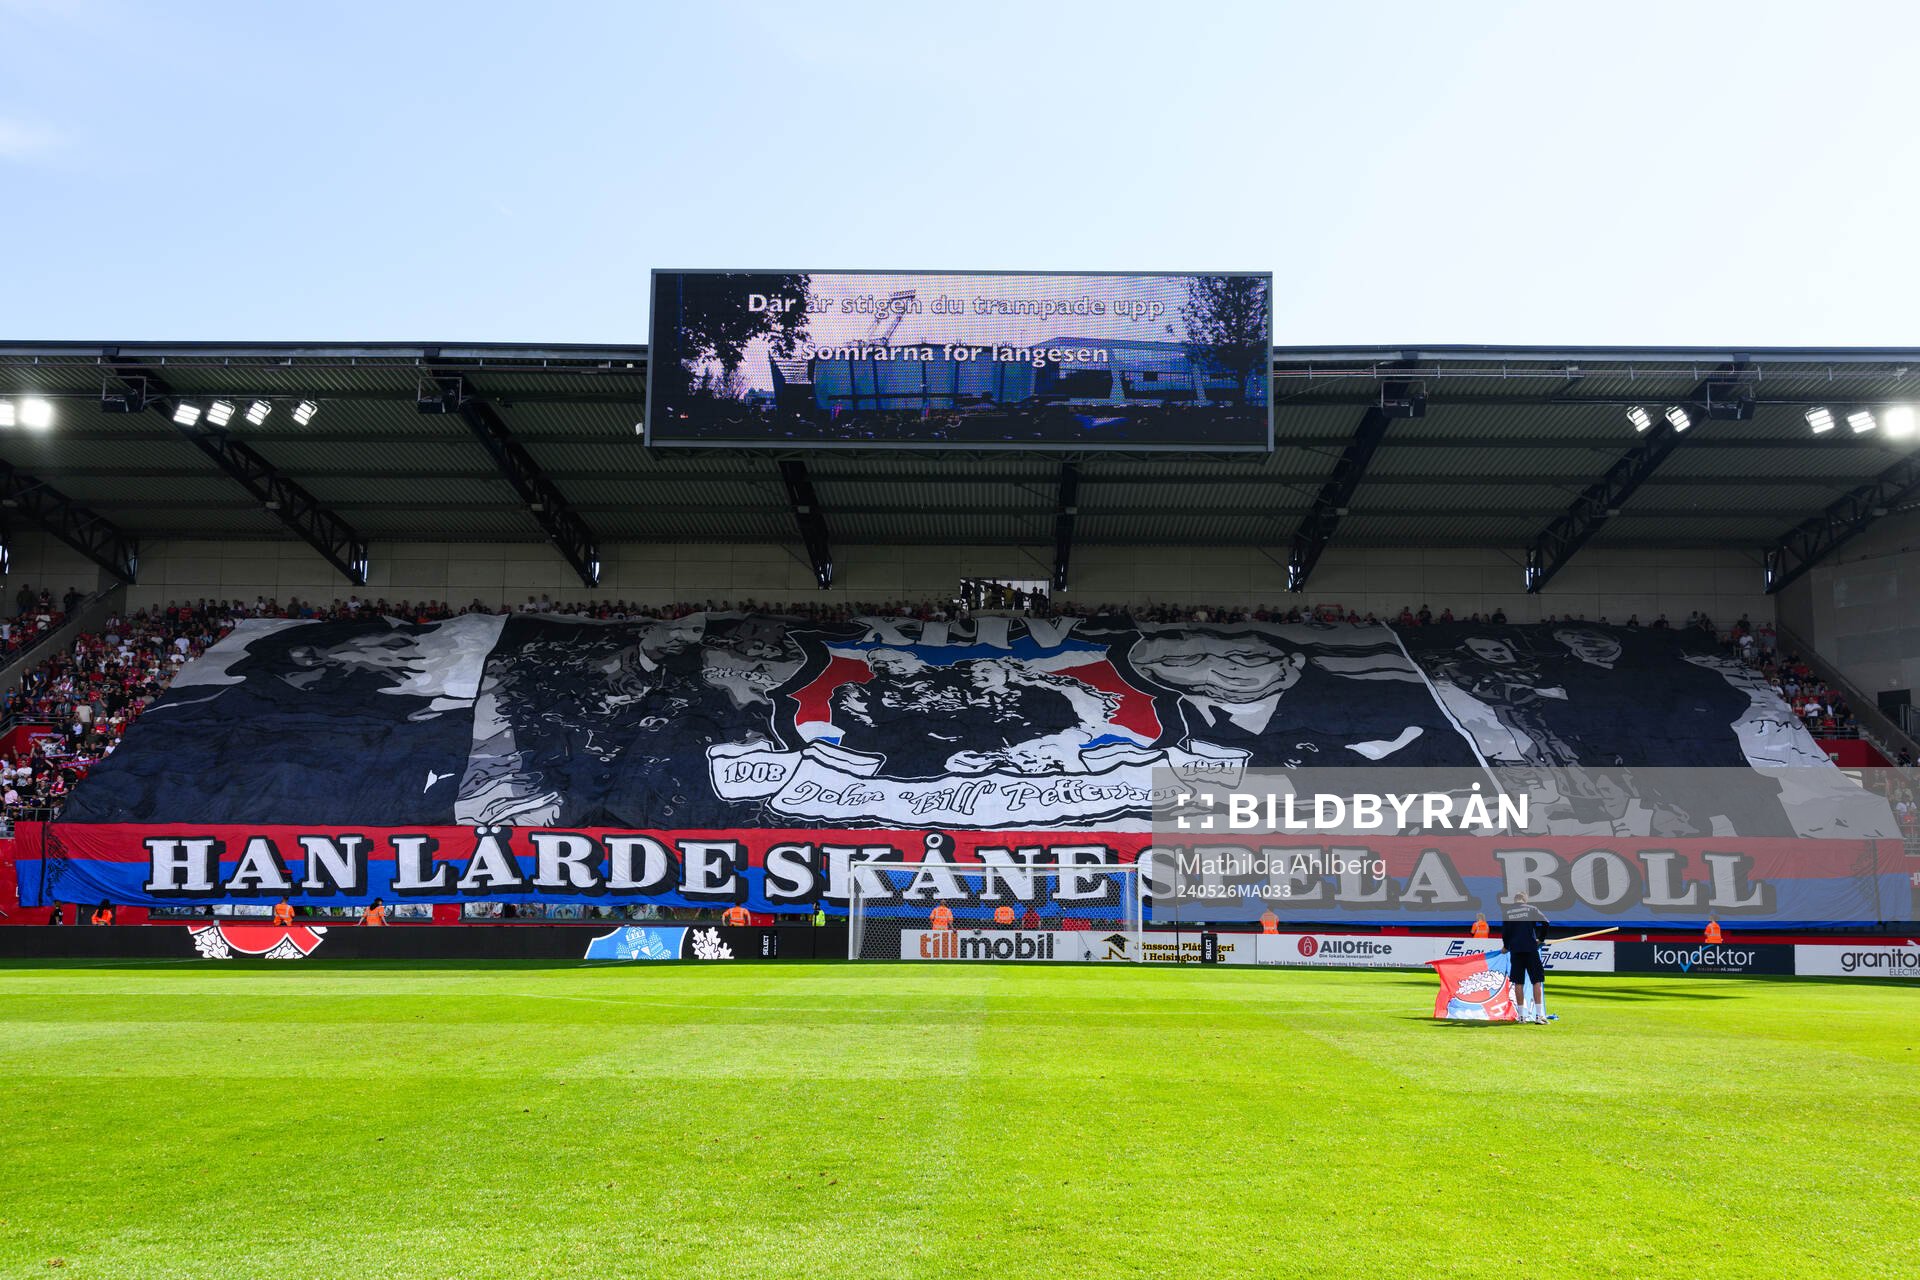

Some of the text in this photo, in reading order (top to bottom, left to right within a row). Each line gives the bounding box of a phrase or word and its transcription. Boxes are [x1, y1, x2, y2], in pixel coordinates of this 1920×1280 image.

[748, 293, 1165, 321] Där är stigen du trampade upp
[801, 343, 934, 361] Somrarna
[943, 341, 982, 362] för
[724, 761, 786, 783] 1908
[782, 780, 885, 806] John
[144, 825, 1763, 906] HAN LÄRDE SKÅNE SPELA BOLL
[919, 932, 1054, 960] tillmobil
[1319, 940, 1392, 954] AllOffice
[1551, 951, 1602, 960] BOLAGET
[1653, 944, 1756, 966] kondektor
[1889, 968, 1920, 976] ELECTR
